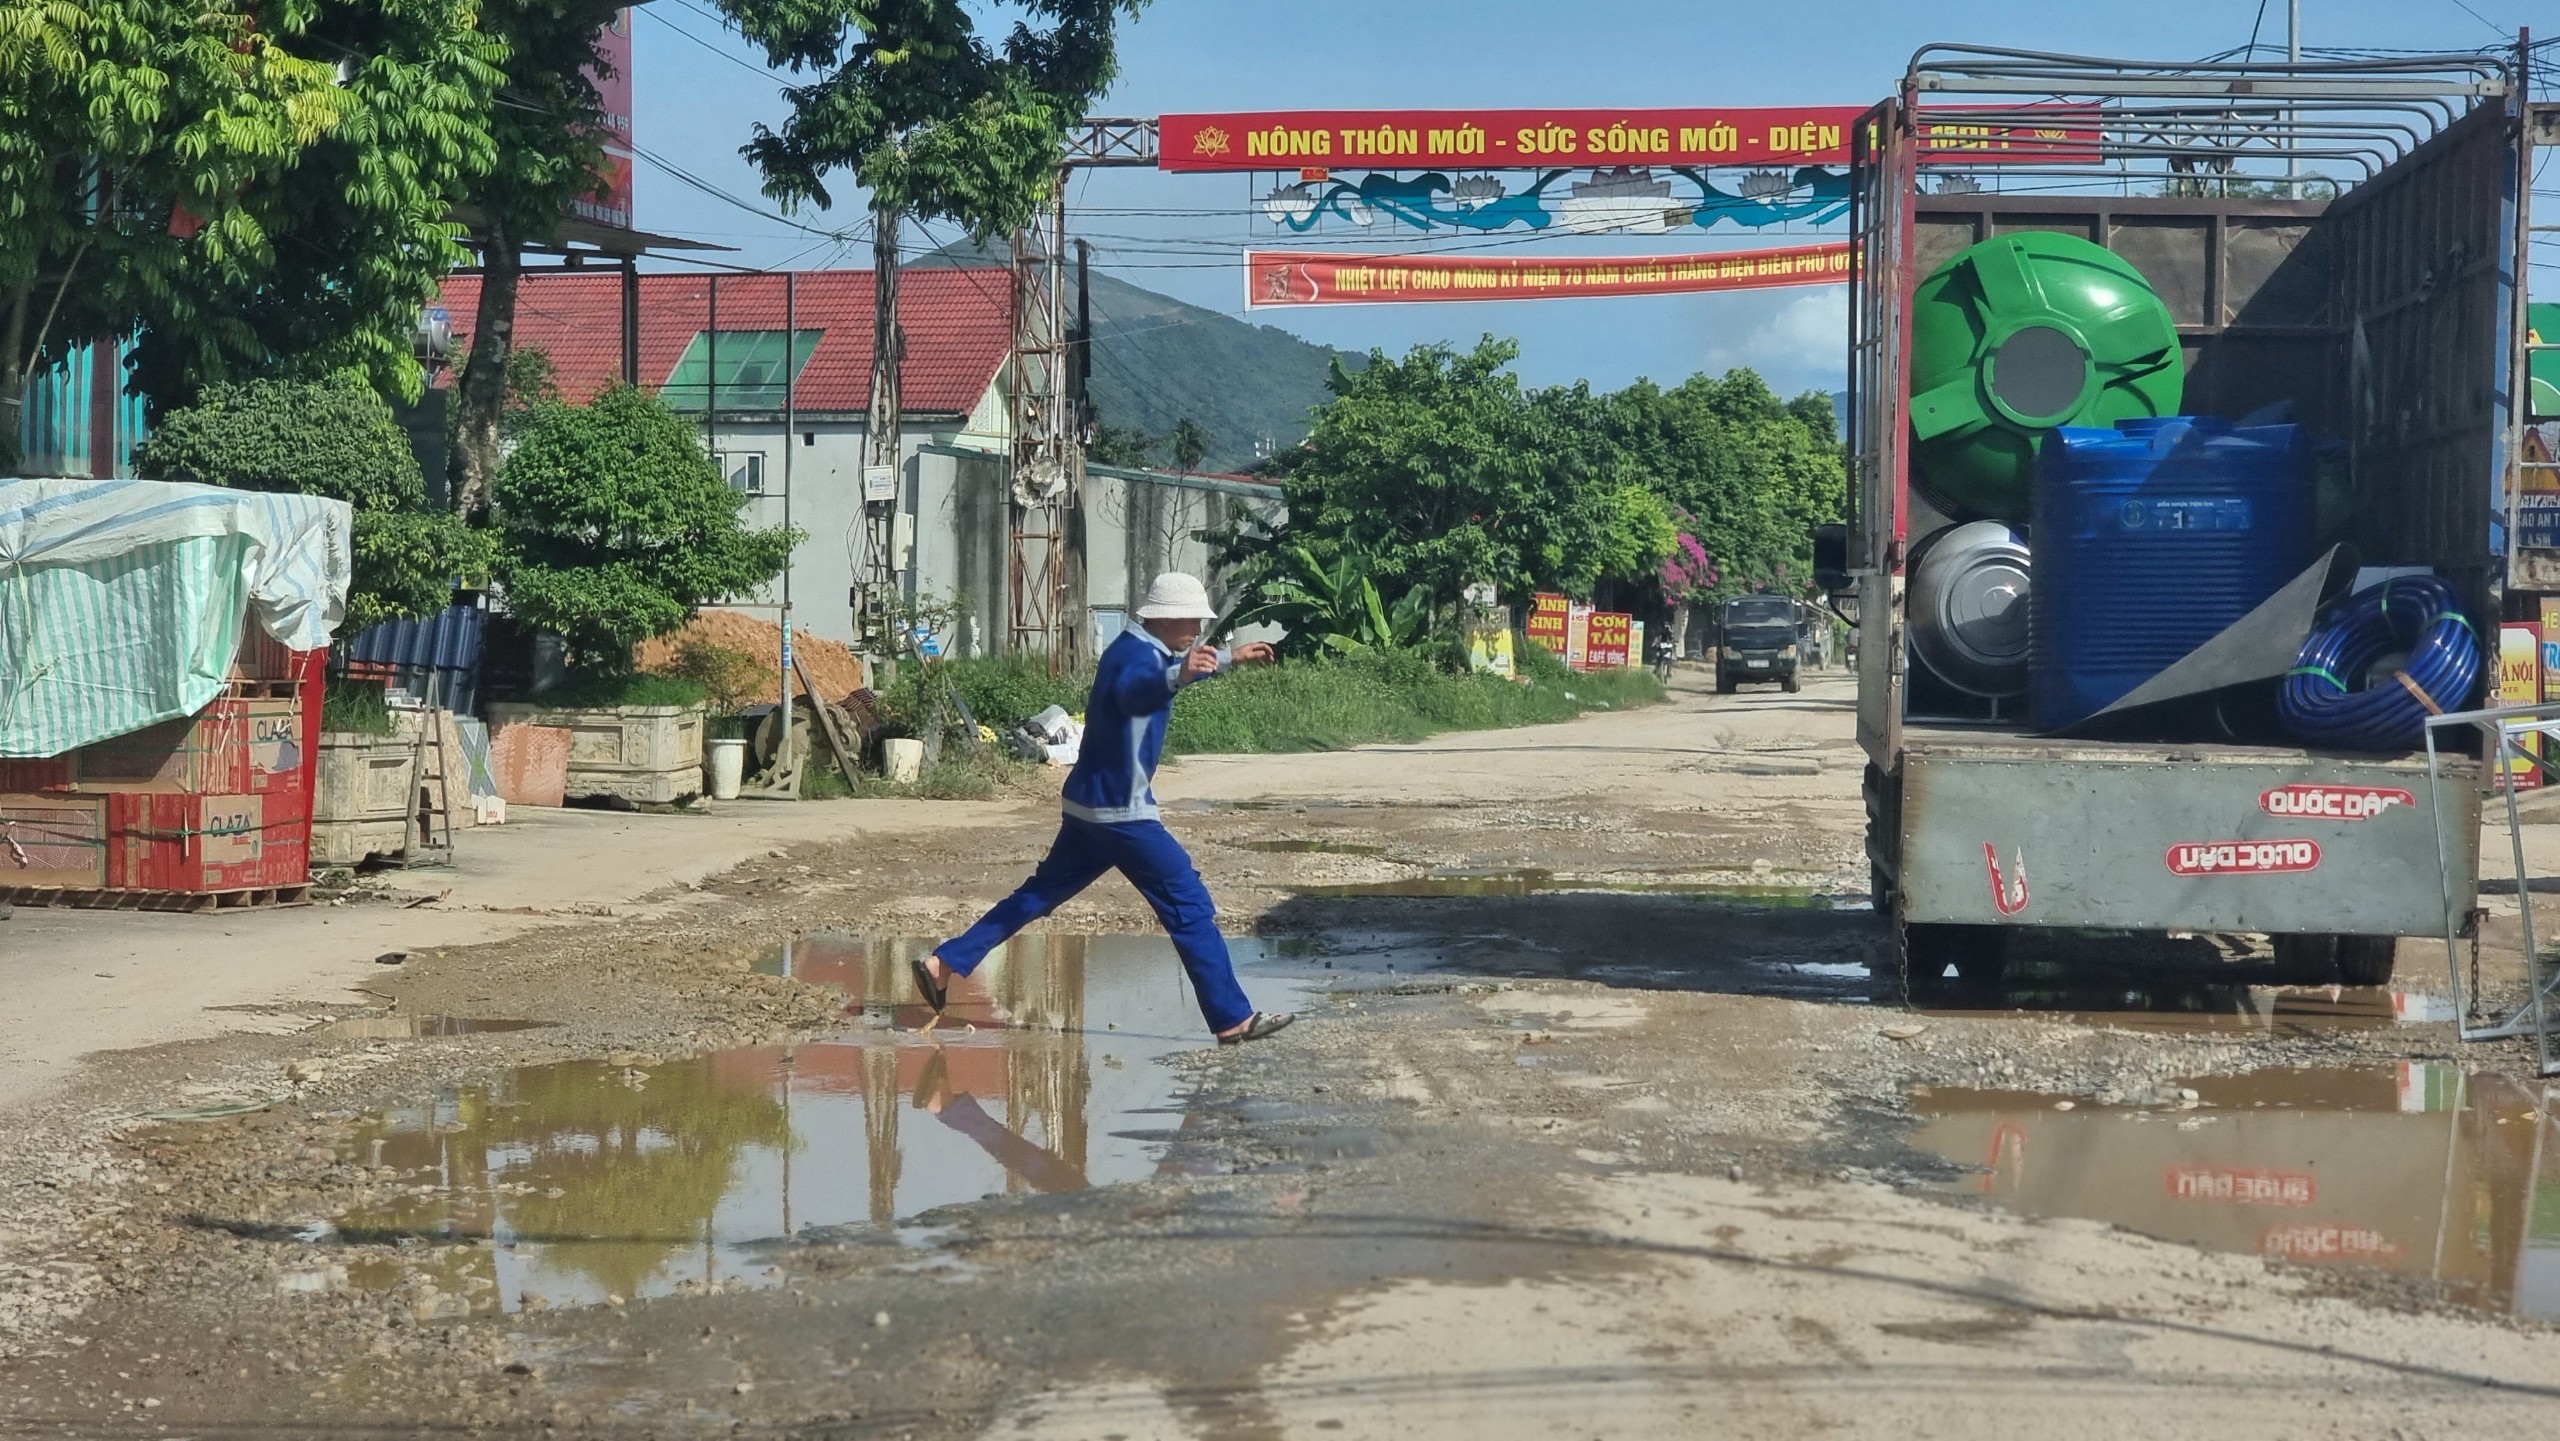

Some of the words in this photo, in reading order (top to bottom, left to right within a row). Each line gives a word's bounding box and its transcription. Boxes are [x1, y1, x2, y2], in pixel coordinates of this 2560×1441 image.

[1248, 125, 1331, 156] NÔNG
[1340, 124, 1418, 155] THÔN
[1428, 122, 1485, 154] MỚI
[1516, 121, 1577, 153] SỨC
[1587, 120, 1669, 153] SỐNG
[1680, 120, 1737, 152] MỚI
[1769, 121, 1840, 156] DIỆN
[1335, 265, 1376, 296] NHIỆT
[1380, 266, 1408, 295] LIỆT
[1412, 266, 1450, 289] CHÀO
[1523, 263, 1560, 291] NIỆM
[1565, 268, 1582, 285] 70
[1586, 263, 1620, 284] NĂM
[1624, 258, 1666, 282] CHIẾN
[1671, 256, 1717, 281] THẮNG
[1721, 256, 1755, 281] ĐIỆN
[1758, 254, 1792, 275] BIÊN
[1796, 246, 1825, 272] PHỦ
[2519, 512, 2535, 527] AO
[1535, 596, 1568, 612] ÁNH
[1530, 616, 1563, 630] SINH
[1592, 615, 1628, 629] CƠM
[1591, 628, 1626, 646] TẤM
[2511, 660, 2534, 684] NỘI
[2269, 789, 2342, 815] QUỐC
[2238, 843, 2312, 869] QUỐC
